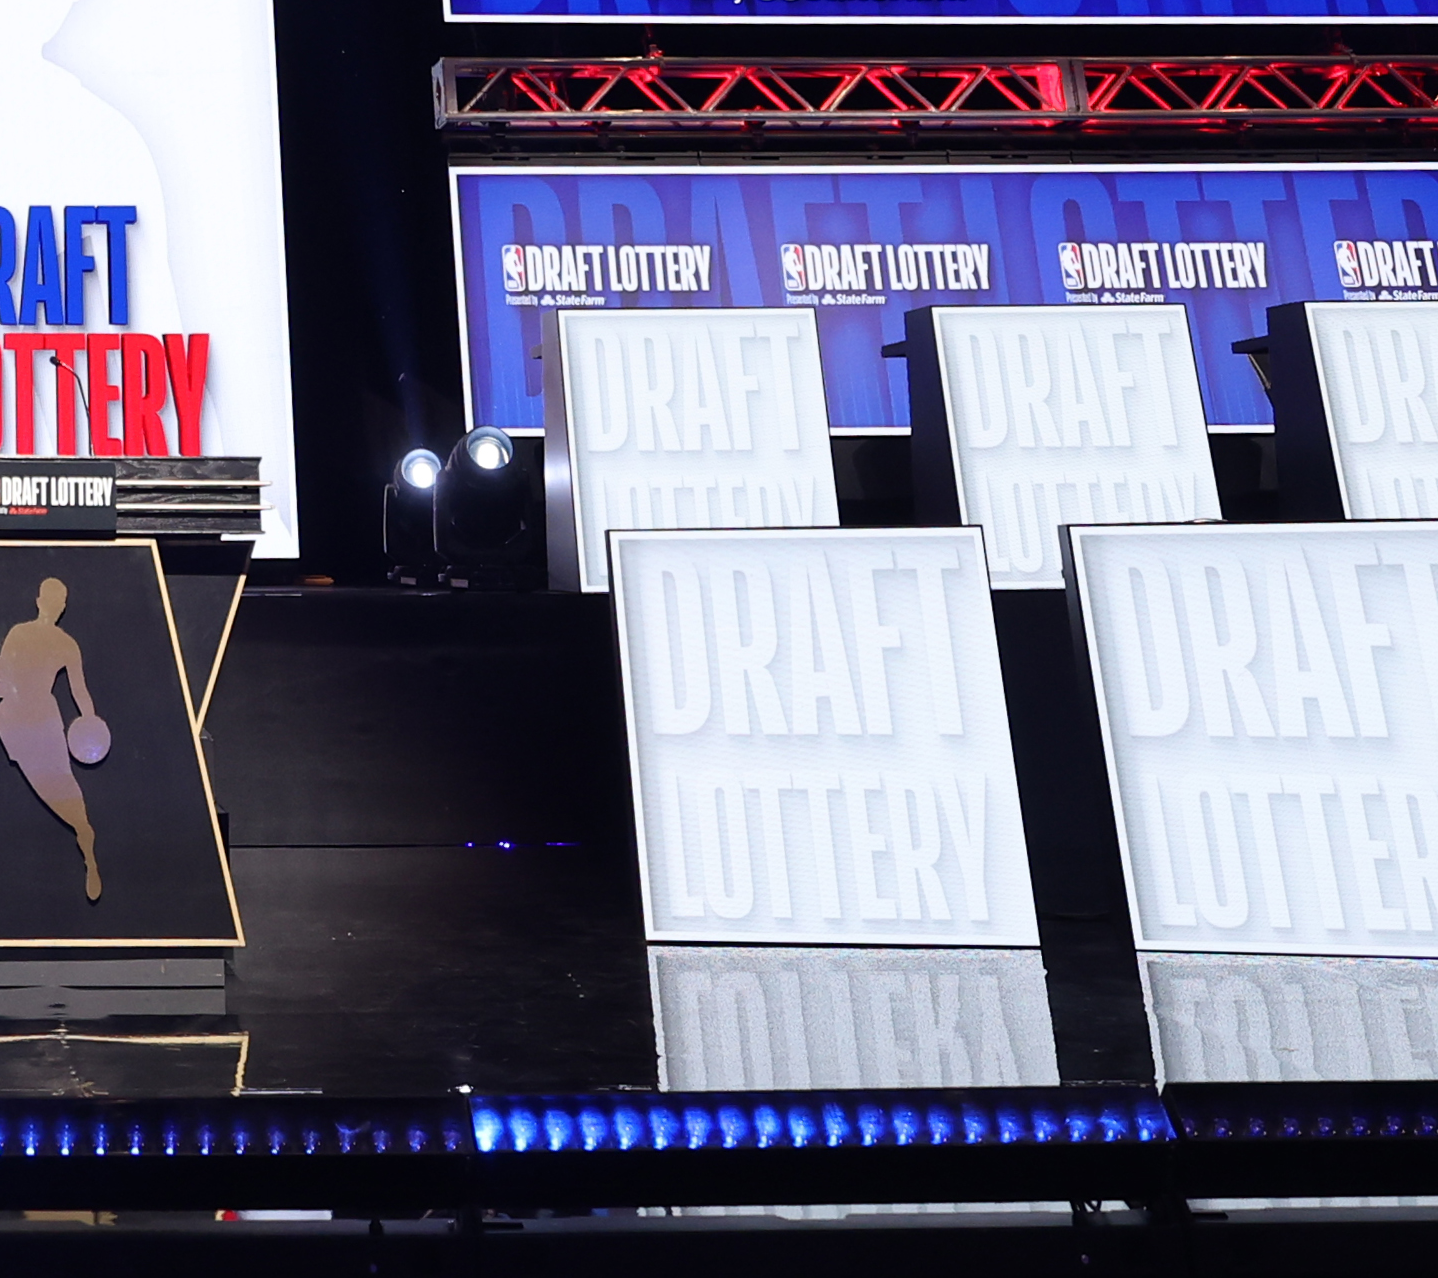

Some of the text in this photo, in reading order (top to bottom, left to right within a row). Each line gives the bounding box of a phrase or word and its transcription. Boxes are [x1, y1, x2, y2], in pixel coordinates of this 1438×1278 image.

[525, 244, 712, 292] DRAFT LOTTERY
[803, 243, 990, 291] DRAFT LOTTERY
[1081, 242, 1268, 289] DRAFT LOTTERY
[1356, 240, 1438, 287] DRAFT
[578, 322, 802, 453] DRAFT
[955, 318, 1179, 450] DRAFT
[1, 476, 114, 507] DRAFT LOTTERY
[641, 546, 965, 738] DRAFT
[661, 771, 991, 924] LOTTERY
